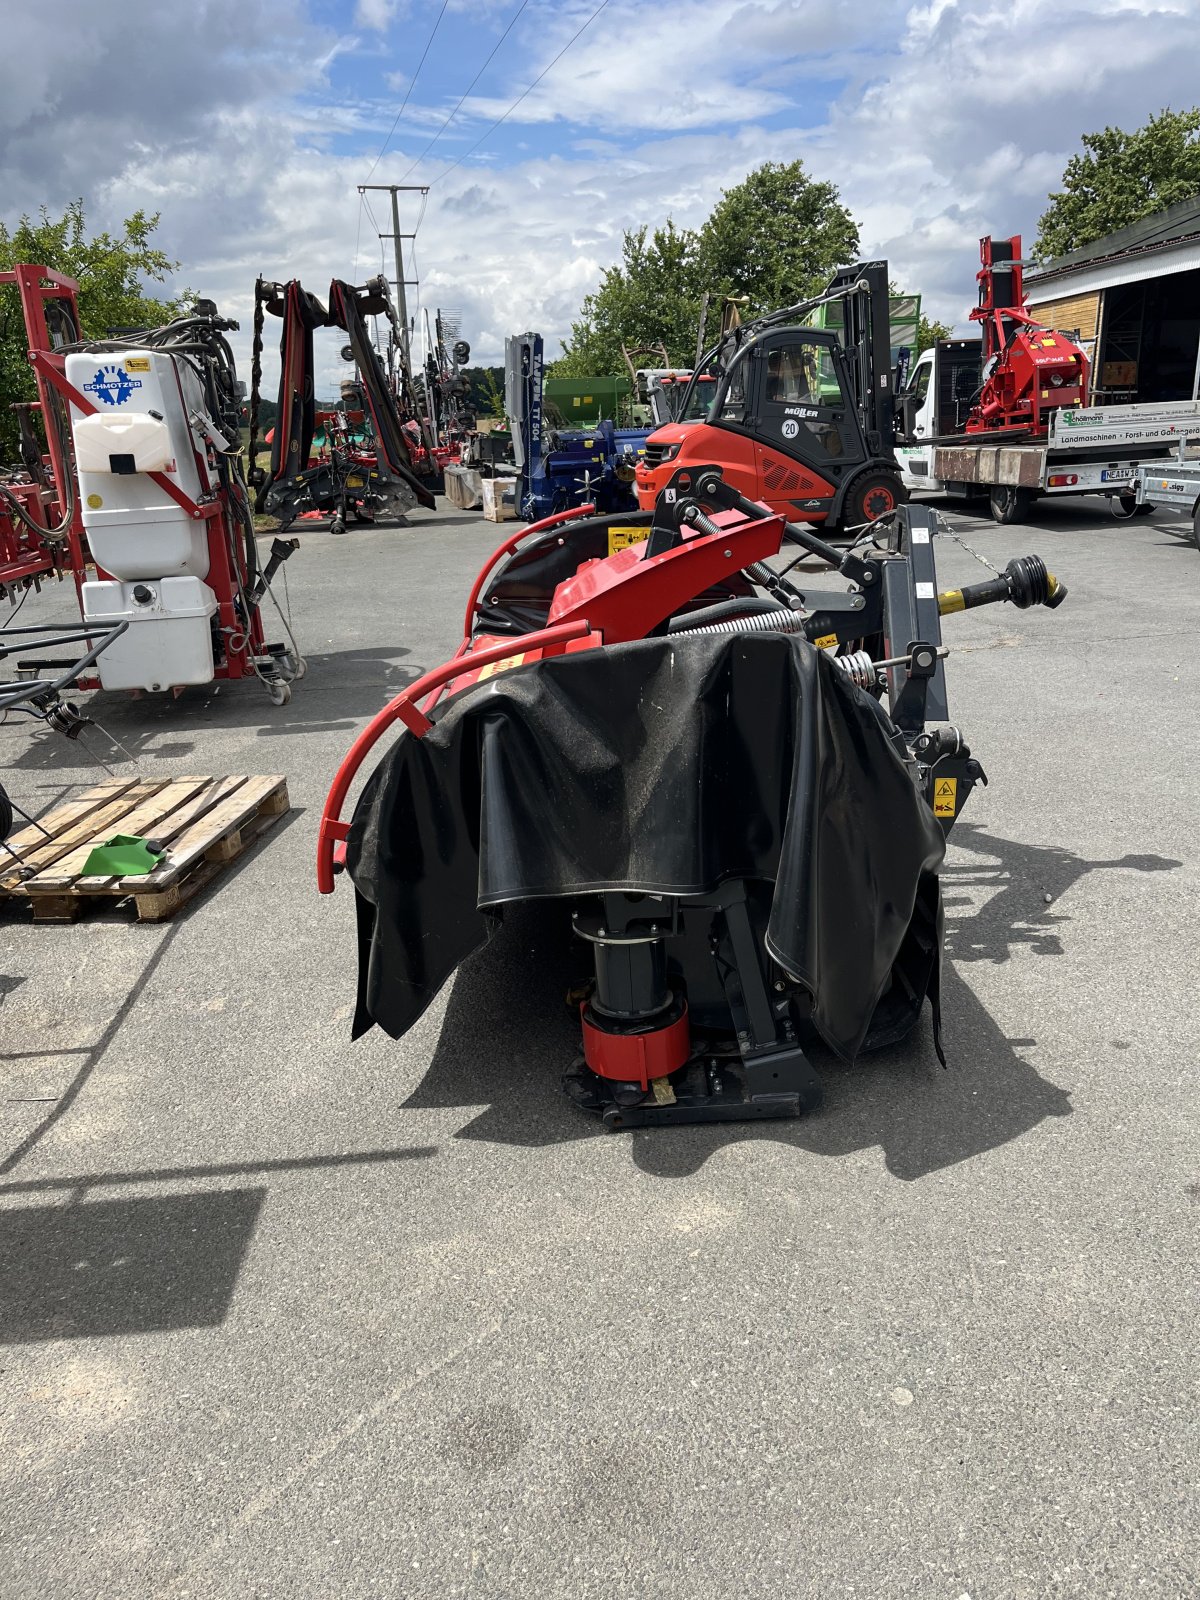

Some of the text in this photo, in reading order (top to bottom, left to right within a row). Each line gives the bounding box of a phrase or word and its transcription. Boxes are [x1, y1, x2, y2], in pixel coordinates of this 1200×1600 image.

[84, 381, 141, 391] SCHMOTZER
[532, 407, 540, 420] TT
[784, 407, 818, 418] MÜLLER
[532, 423, 540, 441] 504
[785, 423, 795, 435] 20
[1061, 434, 1116, 443] Landmaschinen
[1106, 470, 1120, 479] NEA
